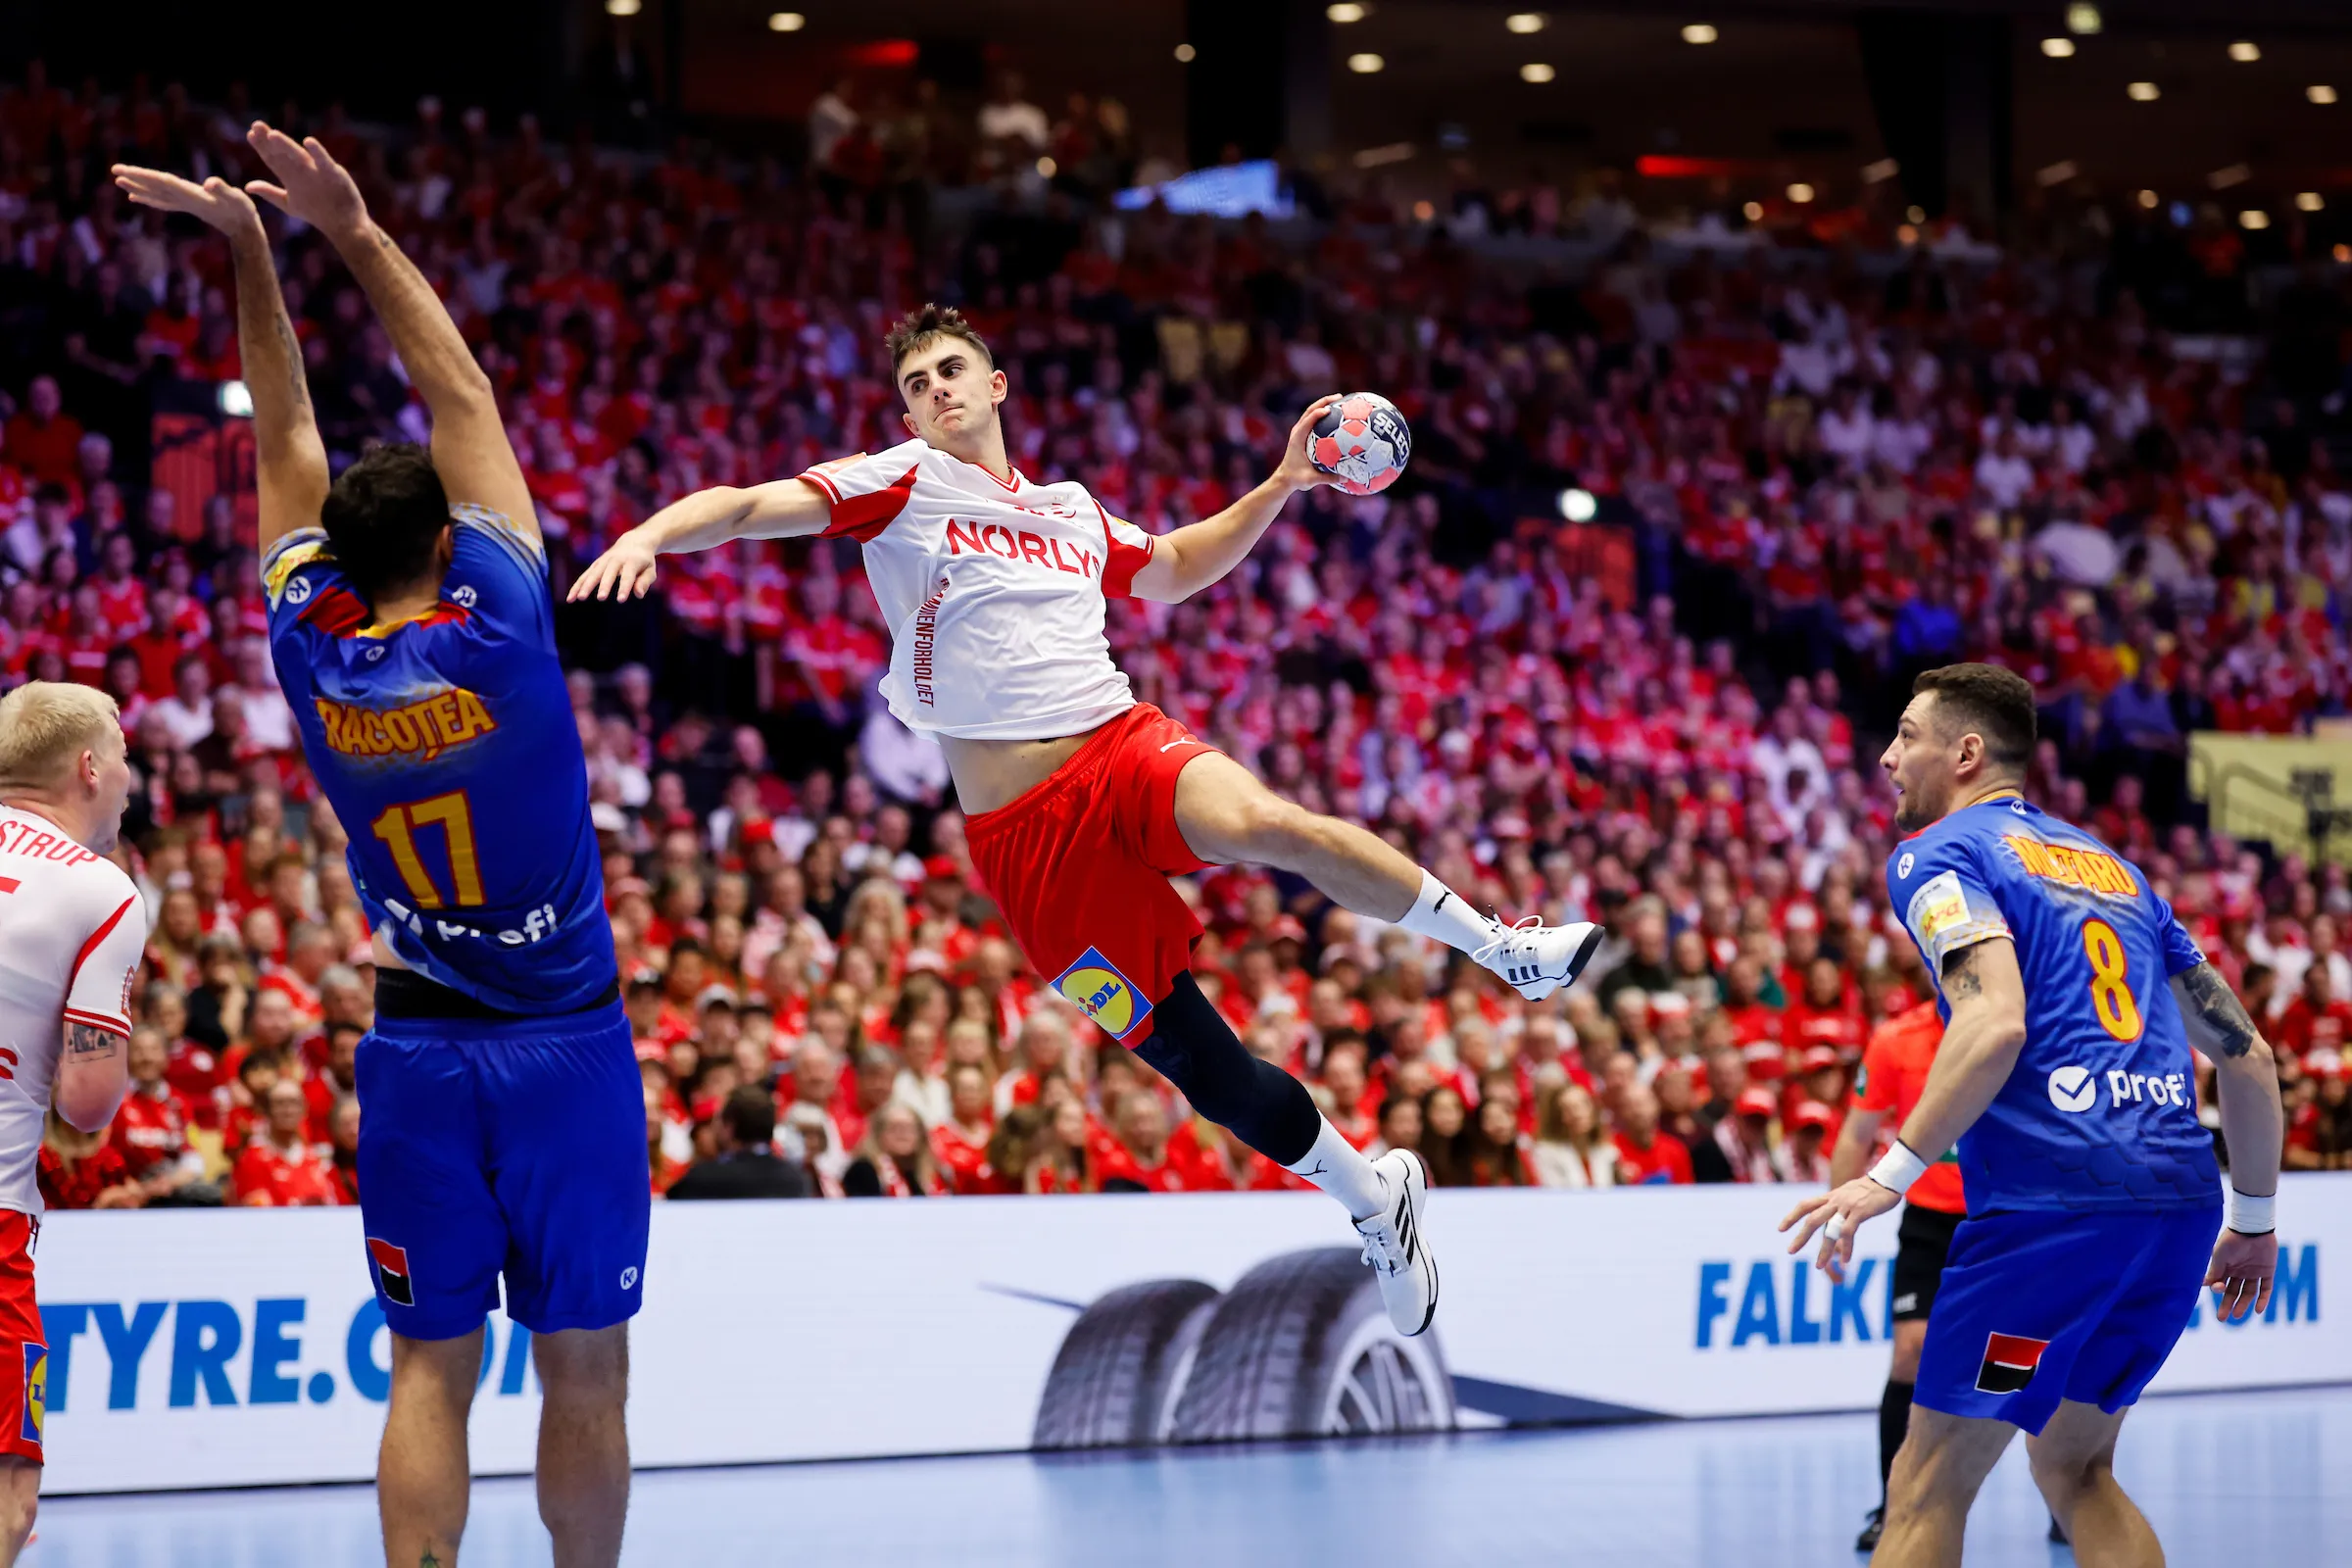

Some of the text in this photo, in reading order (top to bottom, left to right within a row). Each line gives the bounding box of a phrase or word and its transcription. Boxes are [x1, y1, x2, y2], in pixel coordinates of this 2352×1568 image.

[1373, 412, 1409, 461] SELEC
[369, 788, 488, 909] 17
[2082, 918, 2142, 1043] 8
